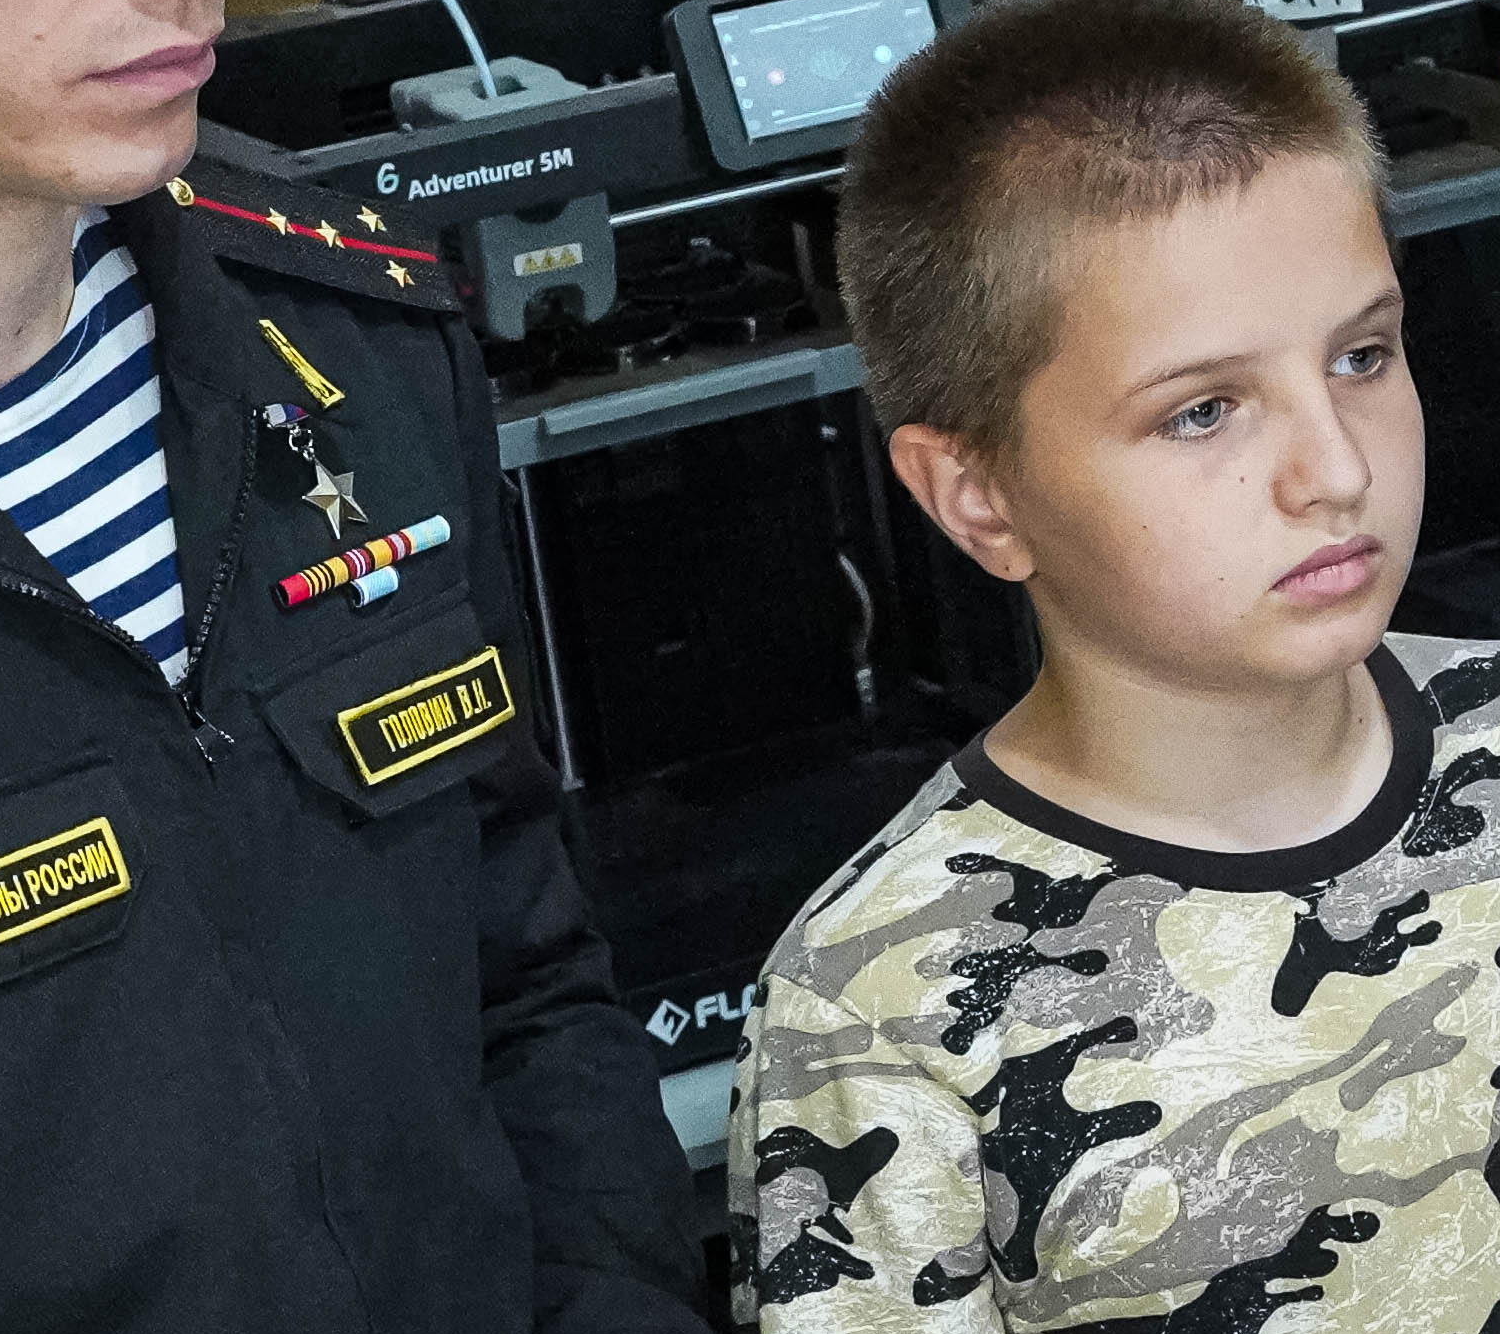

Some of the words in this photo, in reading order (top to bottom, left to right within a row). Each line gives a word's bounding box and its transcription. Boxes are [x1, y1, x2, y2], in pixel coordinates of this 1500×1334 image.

[376, 162, 400, 194] 6
[408, 158, 535, 201] Adventurer
[539, 147, 574, 173] 5M
[378, 692, 458, 752] ГОЛОВИН
[23, 839, 115, 905] РОССИИ
